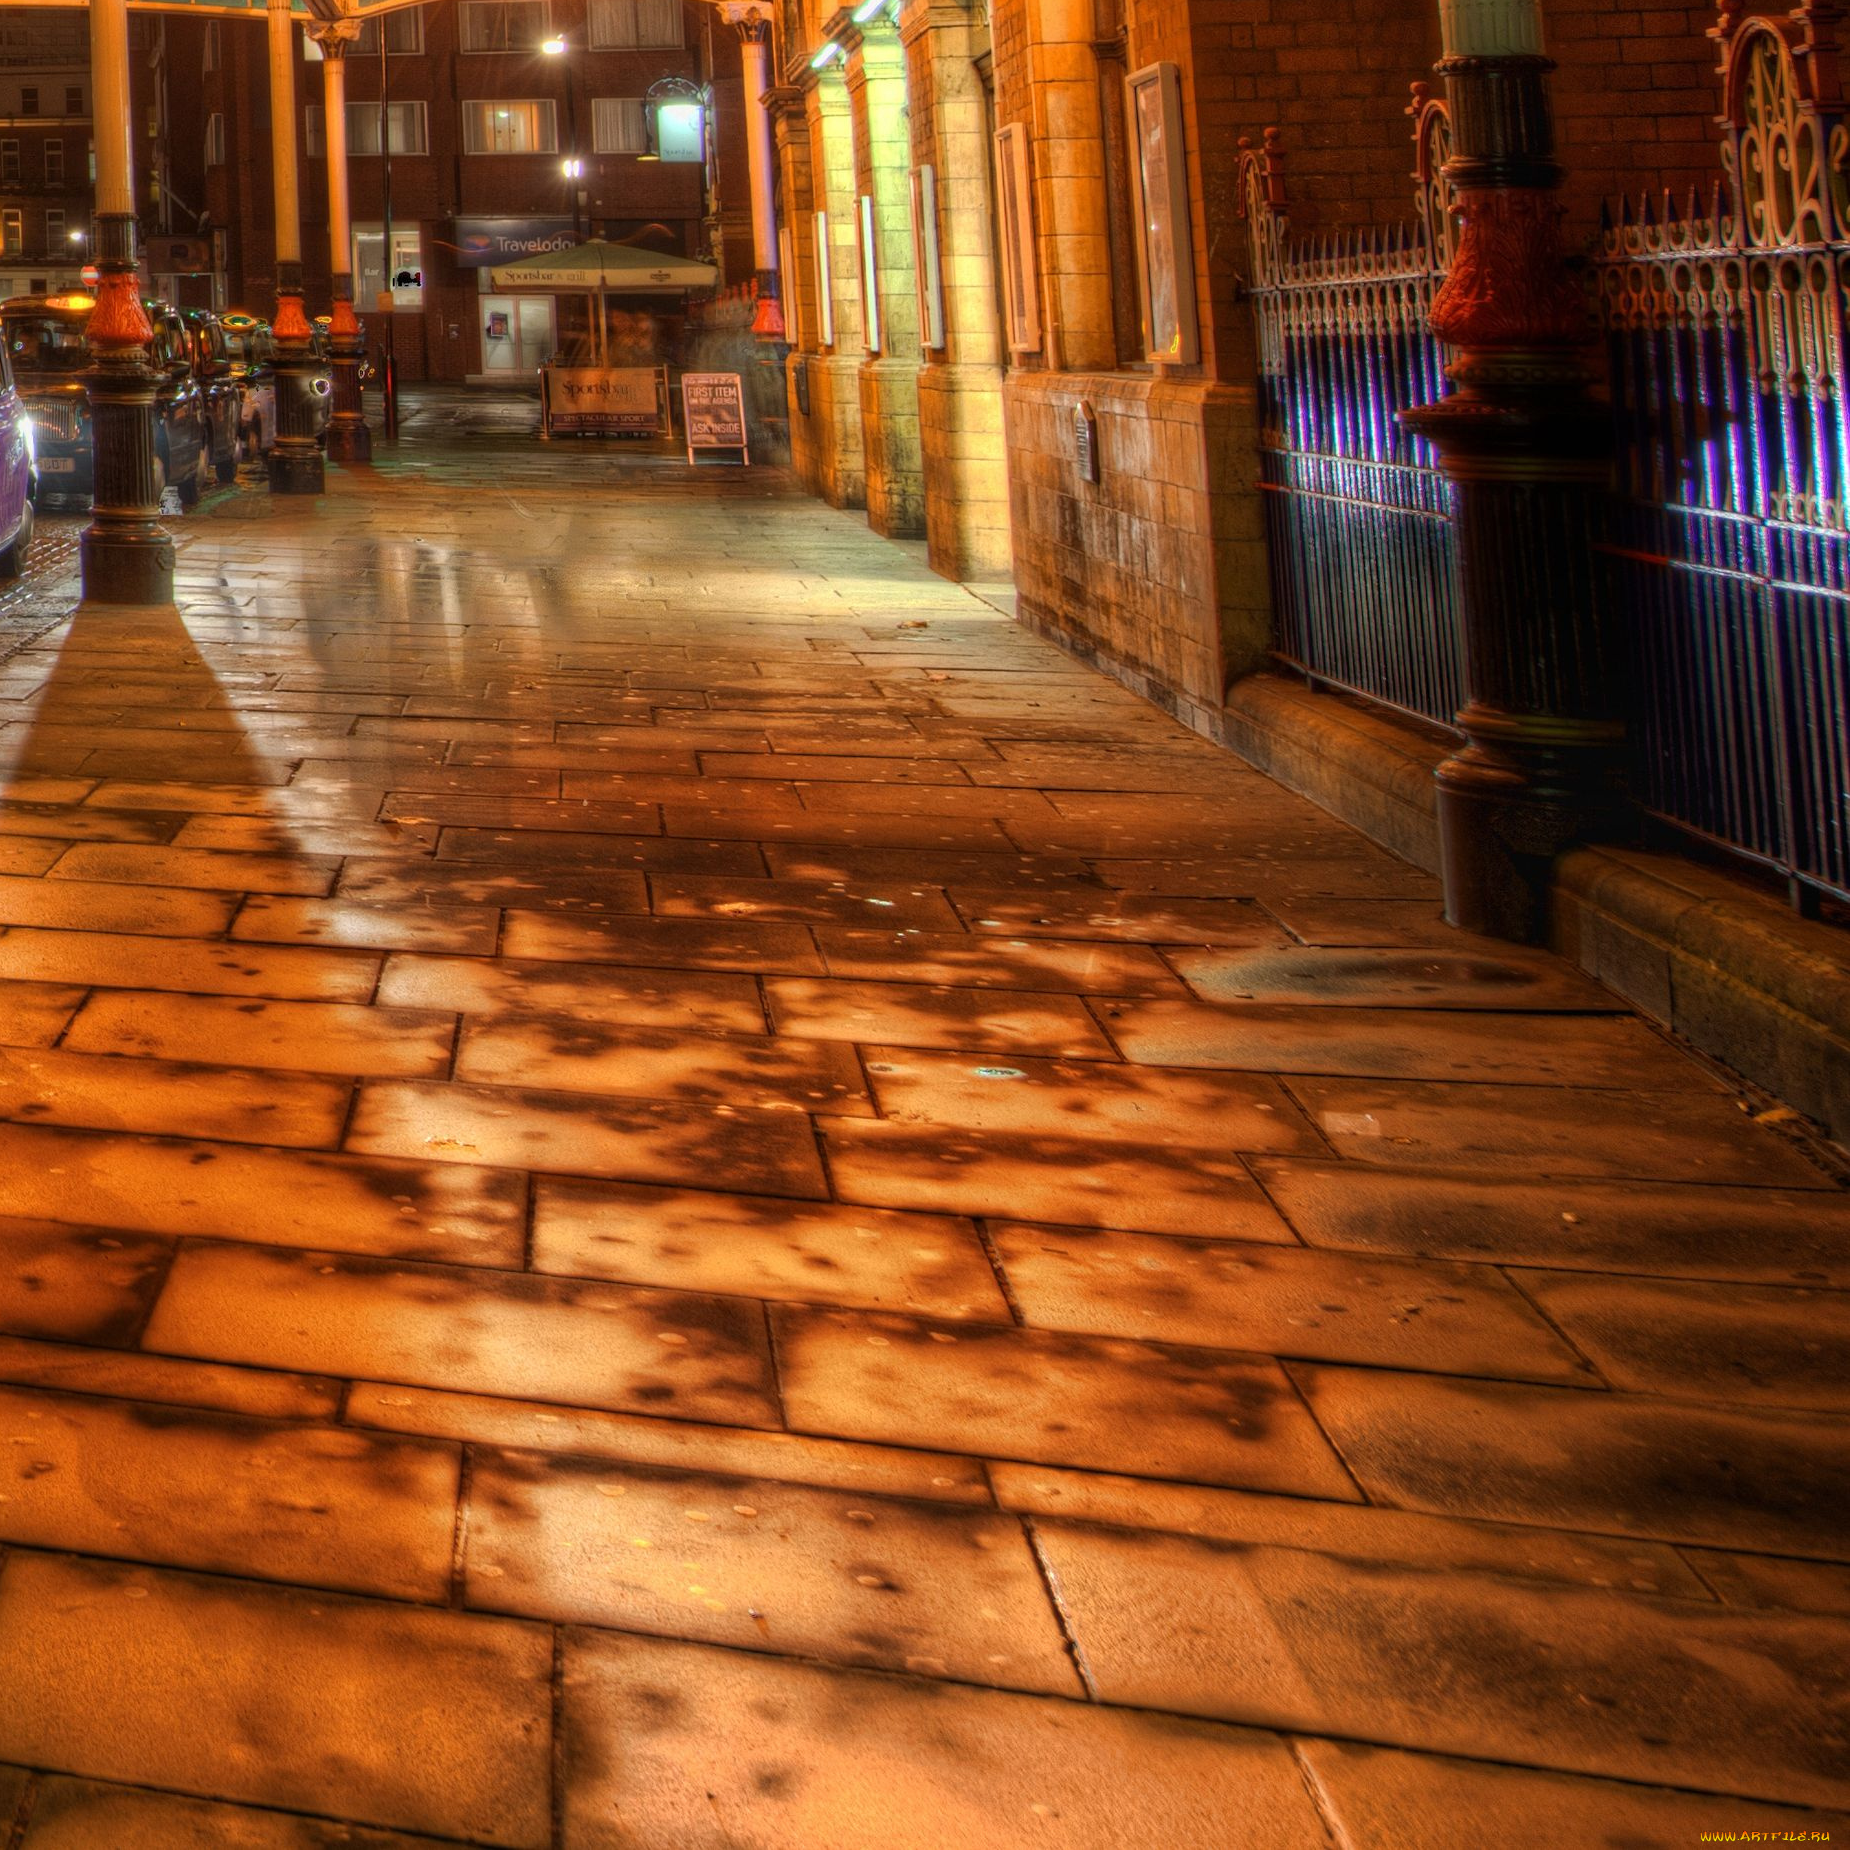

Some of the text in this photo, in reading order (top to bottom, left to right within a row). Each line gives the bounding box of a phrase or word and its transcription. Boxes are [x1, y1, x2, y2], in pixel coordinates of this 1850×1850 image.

[688, 386, 738, 398] FIRST ITEM
[563, 414, 645, 423] SPECTACULAR SPORT
[692, 422, 741, 434] ASK INSIDE
